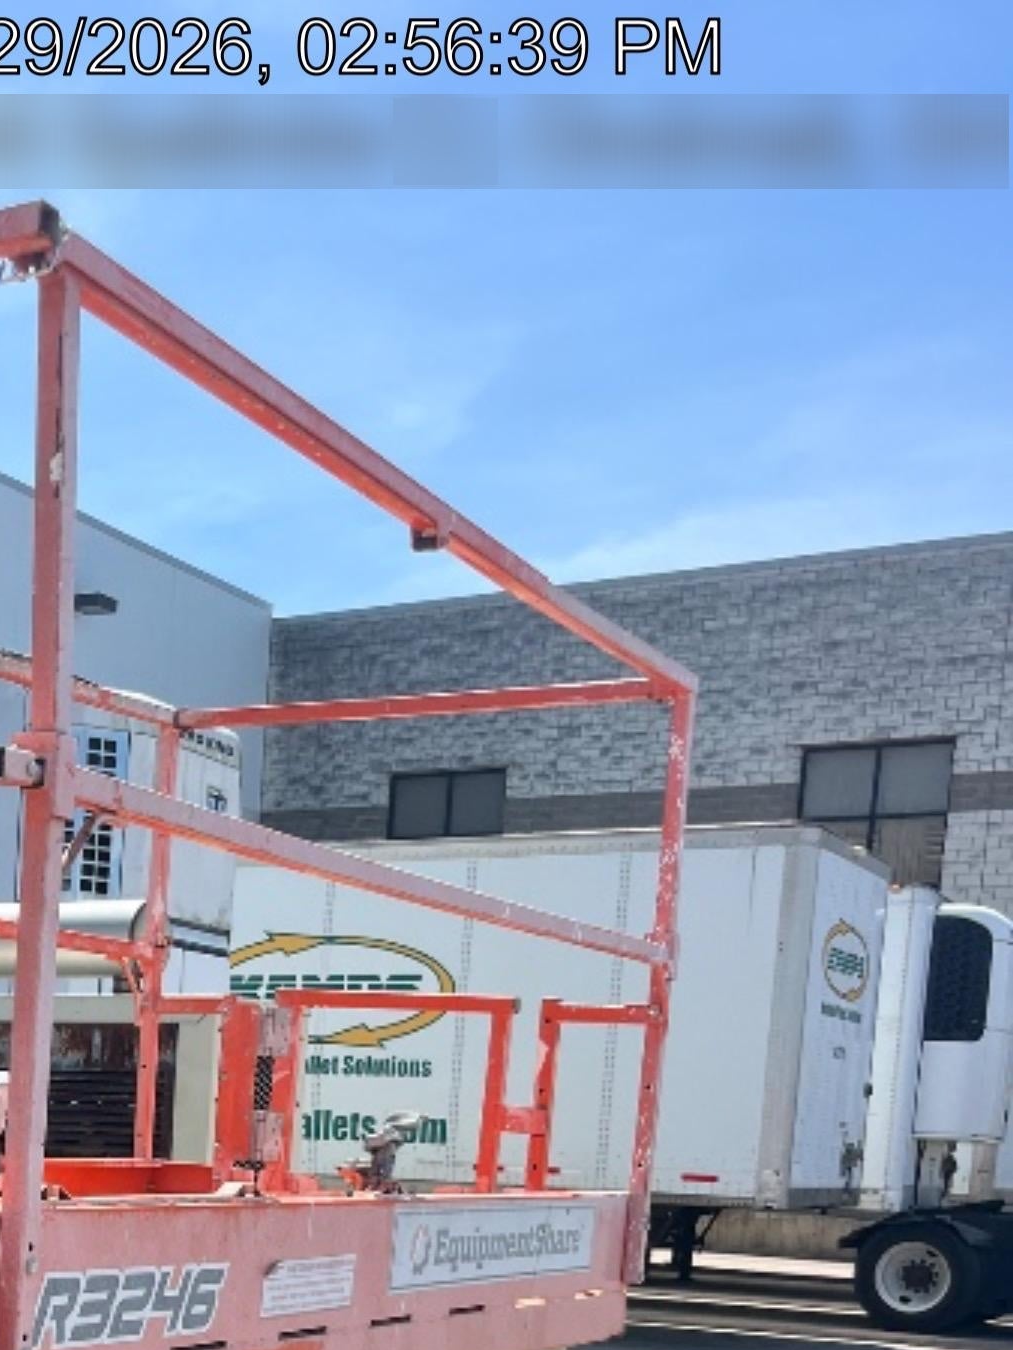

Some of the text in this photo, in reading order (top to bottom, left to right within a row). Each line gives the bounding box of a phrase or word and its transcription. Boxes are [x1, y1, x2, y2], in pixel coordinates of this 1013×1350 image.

[342, 1055, 432, 1078] Solutions
[433, 1222, 580, 1272] EquipmentShare
[32, 1265, 229, 1350] R3246
